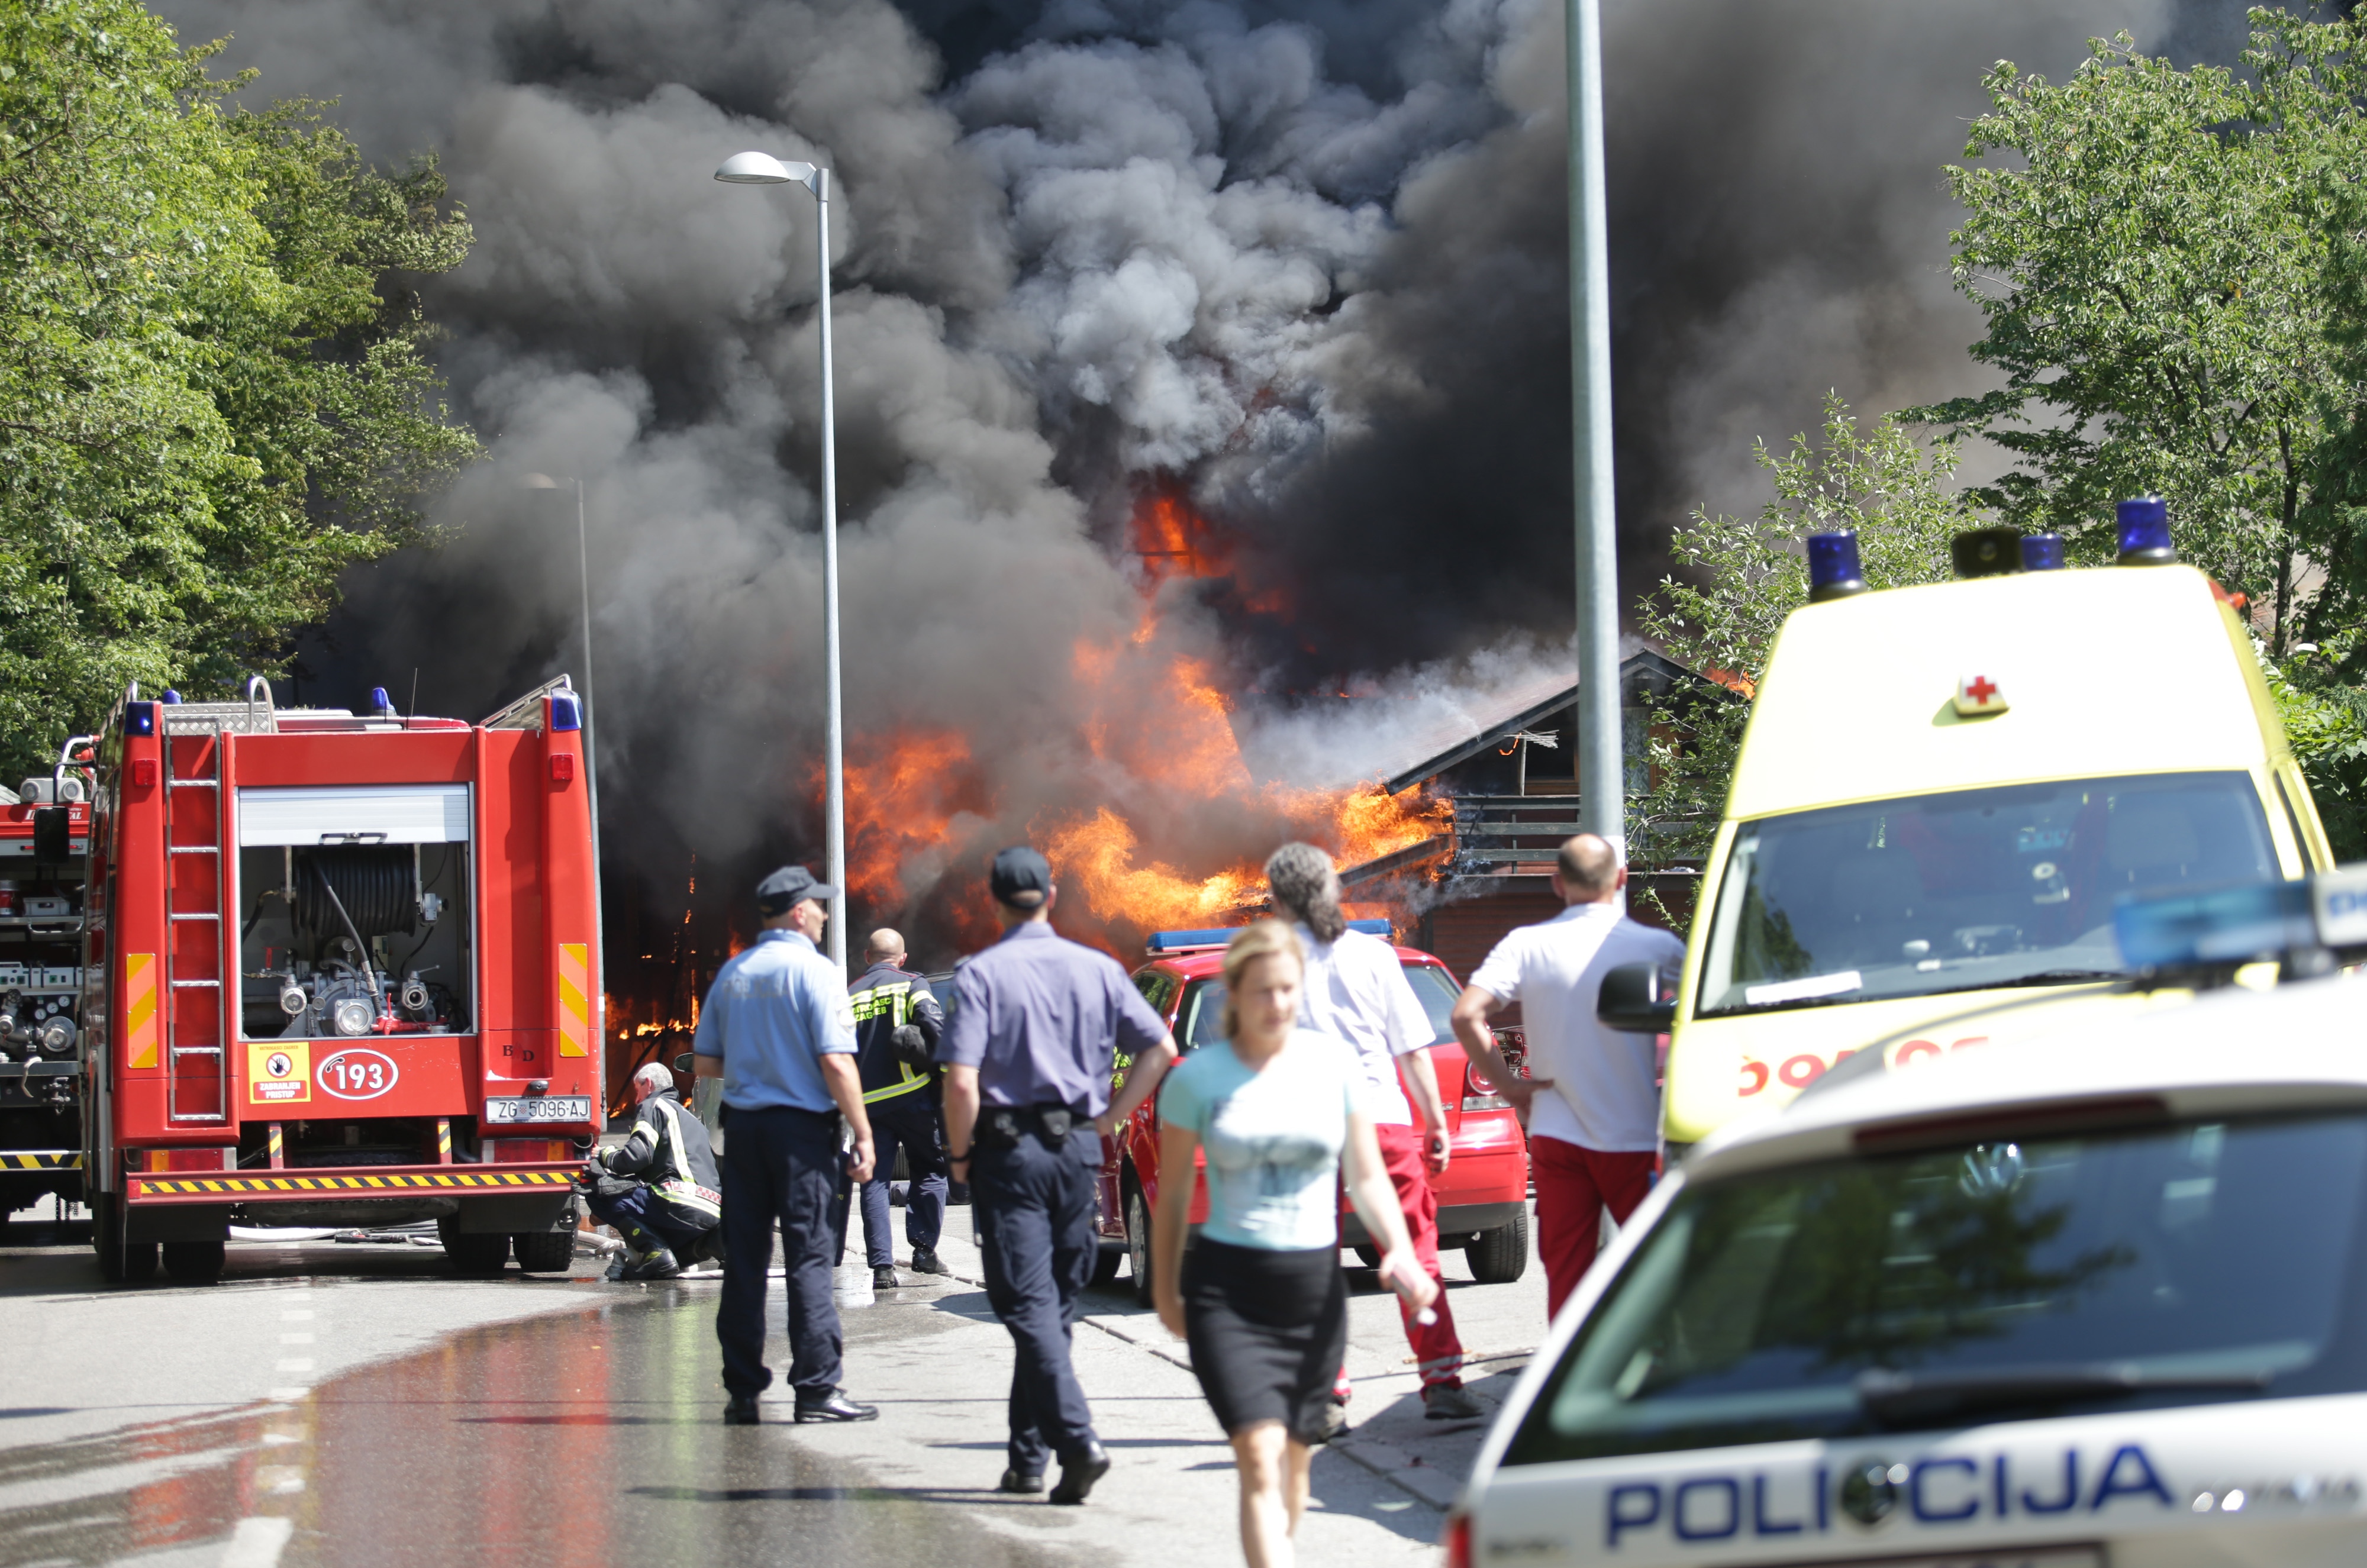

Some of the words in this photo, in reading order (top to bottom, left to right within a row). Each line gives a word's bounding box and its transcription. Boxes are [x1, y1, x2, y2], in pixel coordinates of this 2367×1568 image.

[855, 1006, 887, 1022] ZAGEB
[336, 1063, 383, 1089] 193
[259, 1082, 301, 1091] ZABRANJEN
[266, 1090, 295, 1099] PRISTUP
[499, 1101, 517, 1118] ZG
[528, 1101, 589, 1117] 5096-AJ
[1606, 1444, 2174, 1548] POLICIJA
